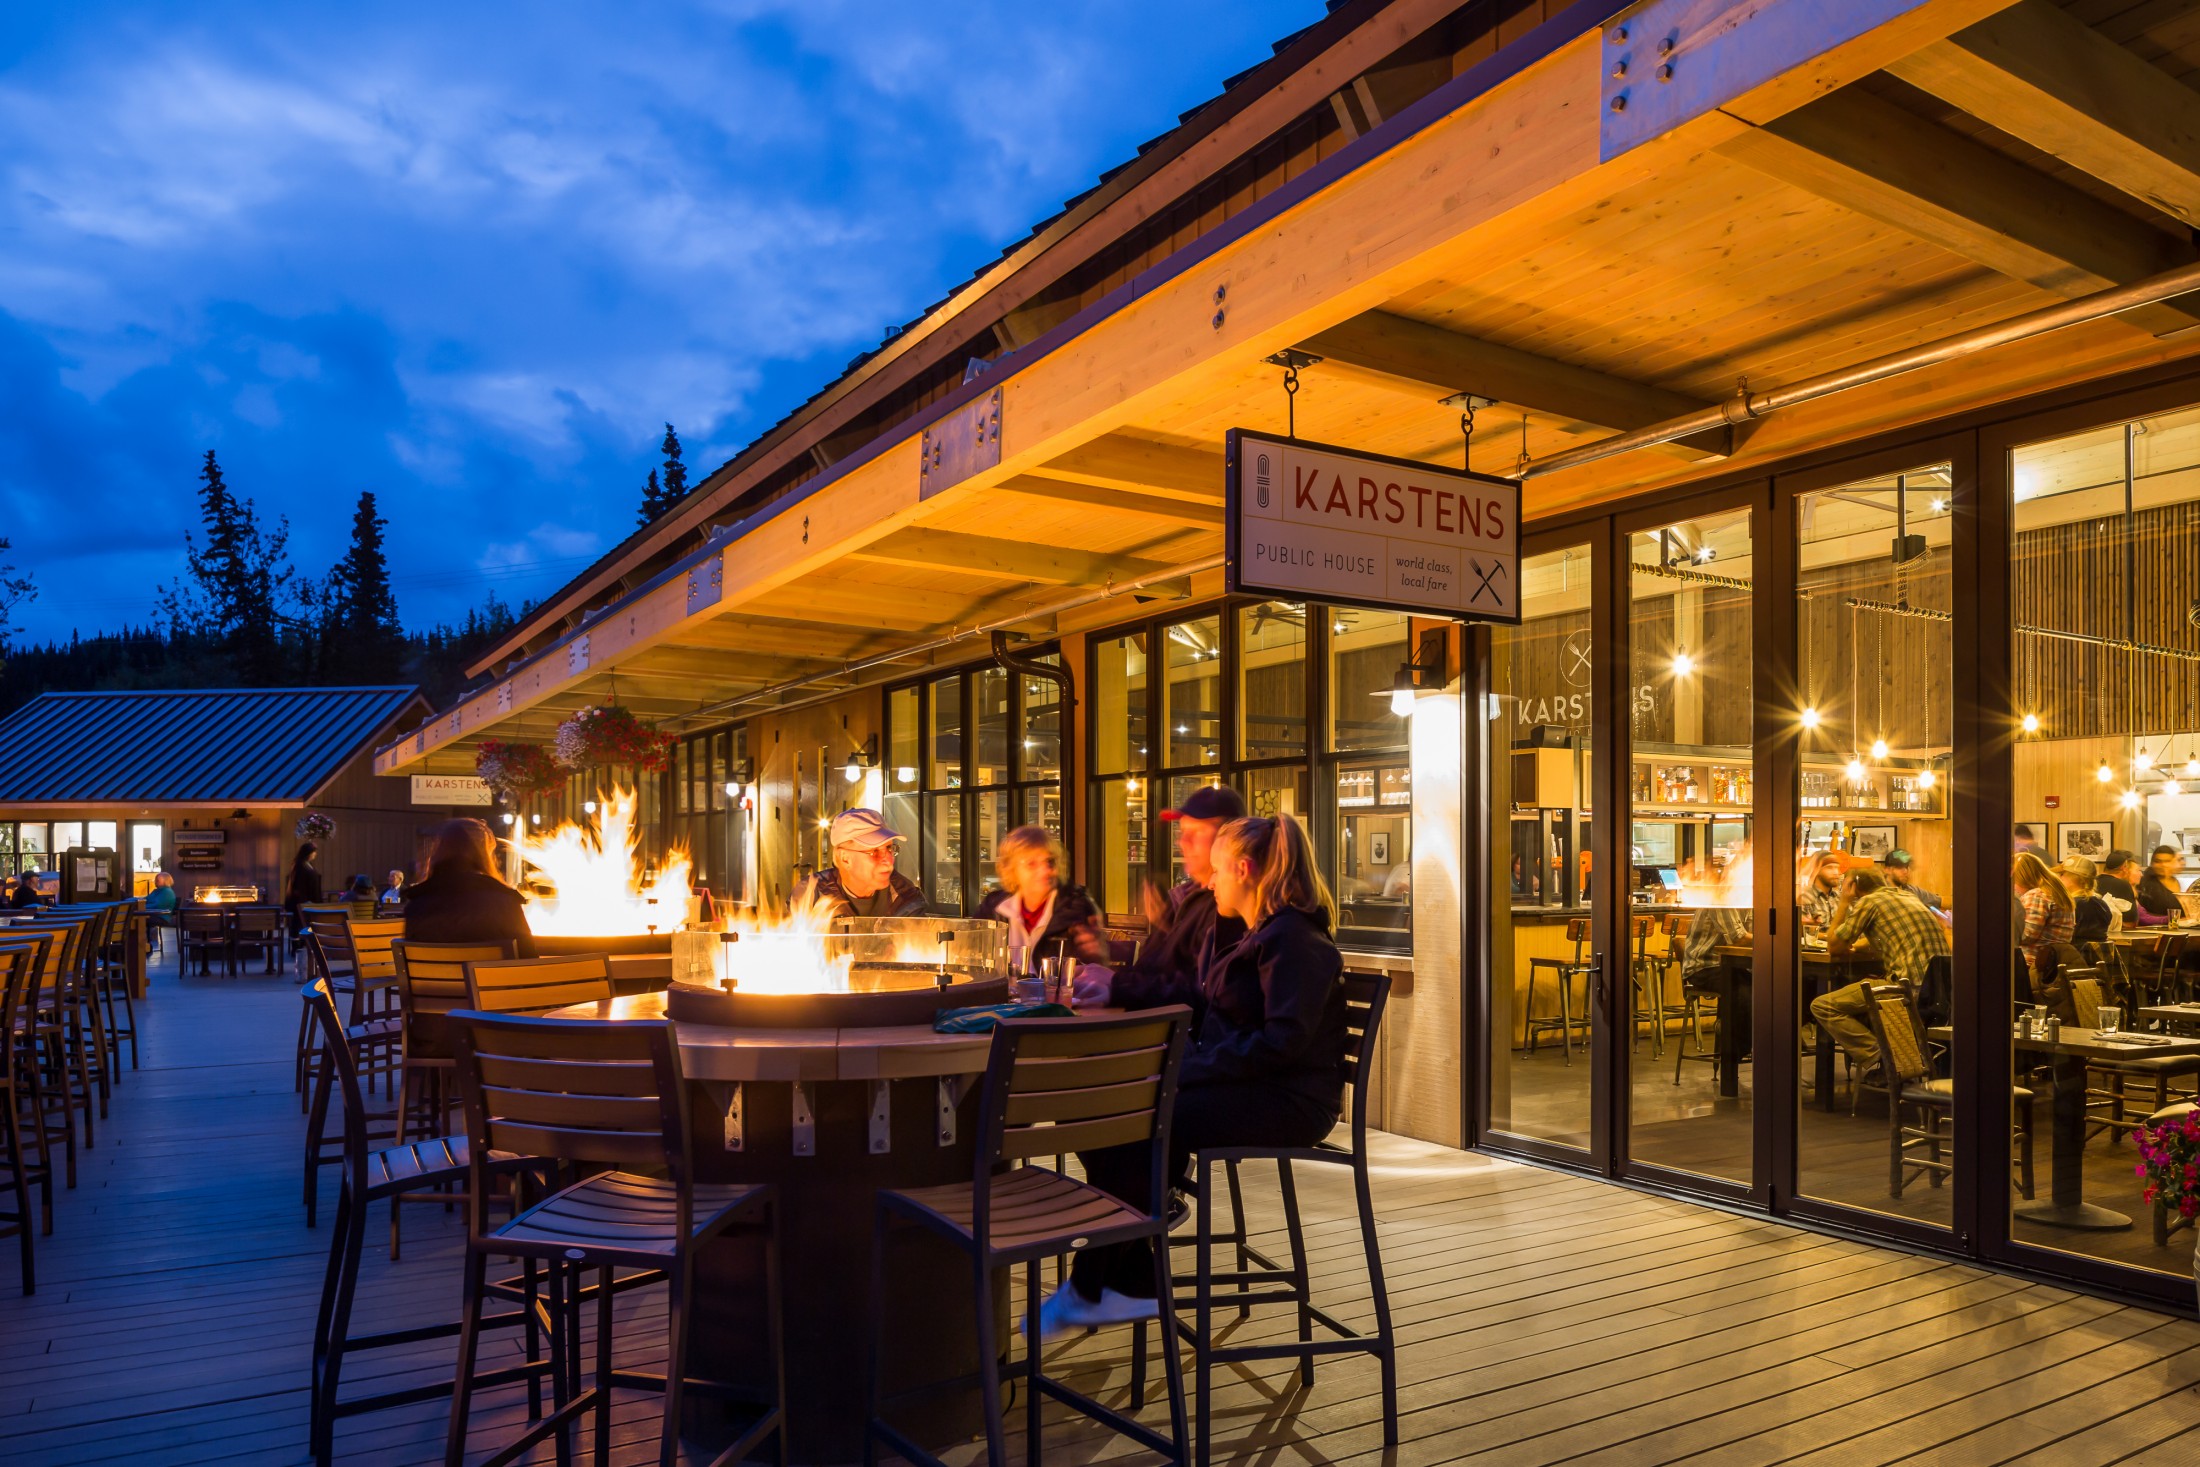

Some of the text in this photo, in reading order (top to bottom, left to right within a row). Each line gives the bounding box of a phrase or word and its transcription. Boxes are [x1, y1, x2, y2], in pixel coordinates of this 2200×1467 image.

[1296, 466, 1504, 540] KARSTENS
[1256, 543, 1375, 575] PUBLIC HOUSE
[1396, 557, 1453, 575] world class,
[1401, 573, 1447, 592] local fare
